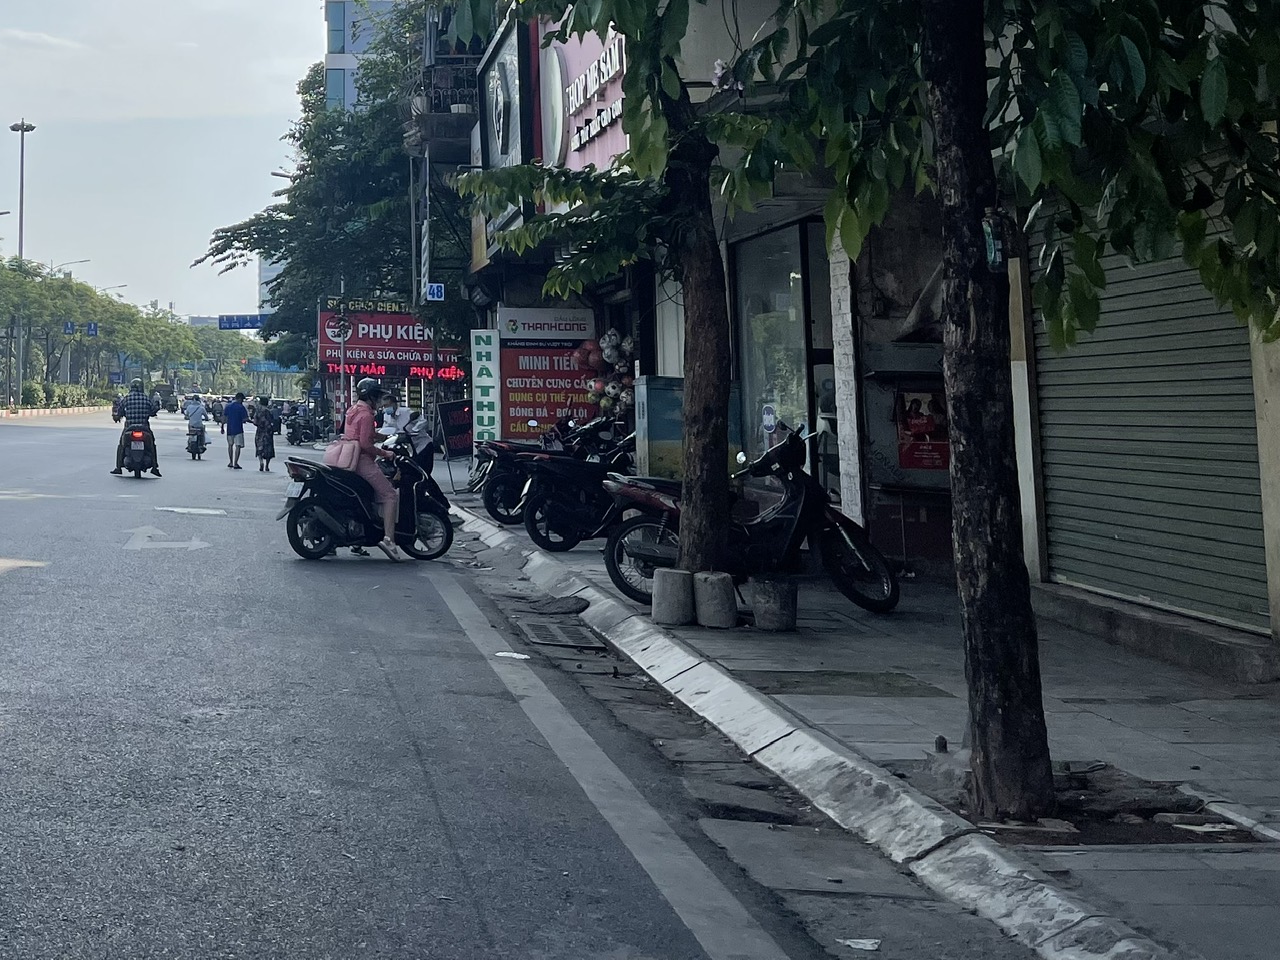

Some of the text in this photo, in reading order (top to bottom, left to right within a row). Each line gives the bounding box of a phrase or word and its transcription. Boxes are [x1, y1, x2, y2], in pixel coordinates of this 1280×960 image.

[566, 73, 586, 117] HOP
[428, 285, 444, 299] 48
[358, 322, 434, 344] PHỤ KIỆN
[346, 348, 367, 361] KIỆN
[368, 352, 375, 360] &
[423, 352, 444, 362] ĐIN
[474, 334, 493, 379] NHÀ
[518, 352, 579, 371] MINH TIẾN
[327, 362, 386, 375] THAY MÀN
[410, 366, 434, 379] PHỤ
[506, 374, 590, 389] CHUYÊN CUNG CẤ
[509, 392, 533, 404] DỤNG
[536, 392, 548, 404] CỤ
[550, 390, 566, 402] THỂ
[475, 385, 496, 441] THUỐ
[509, 406, 534, 417] BÓNG
[536, 406, 548, 418] ĐÁ
